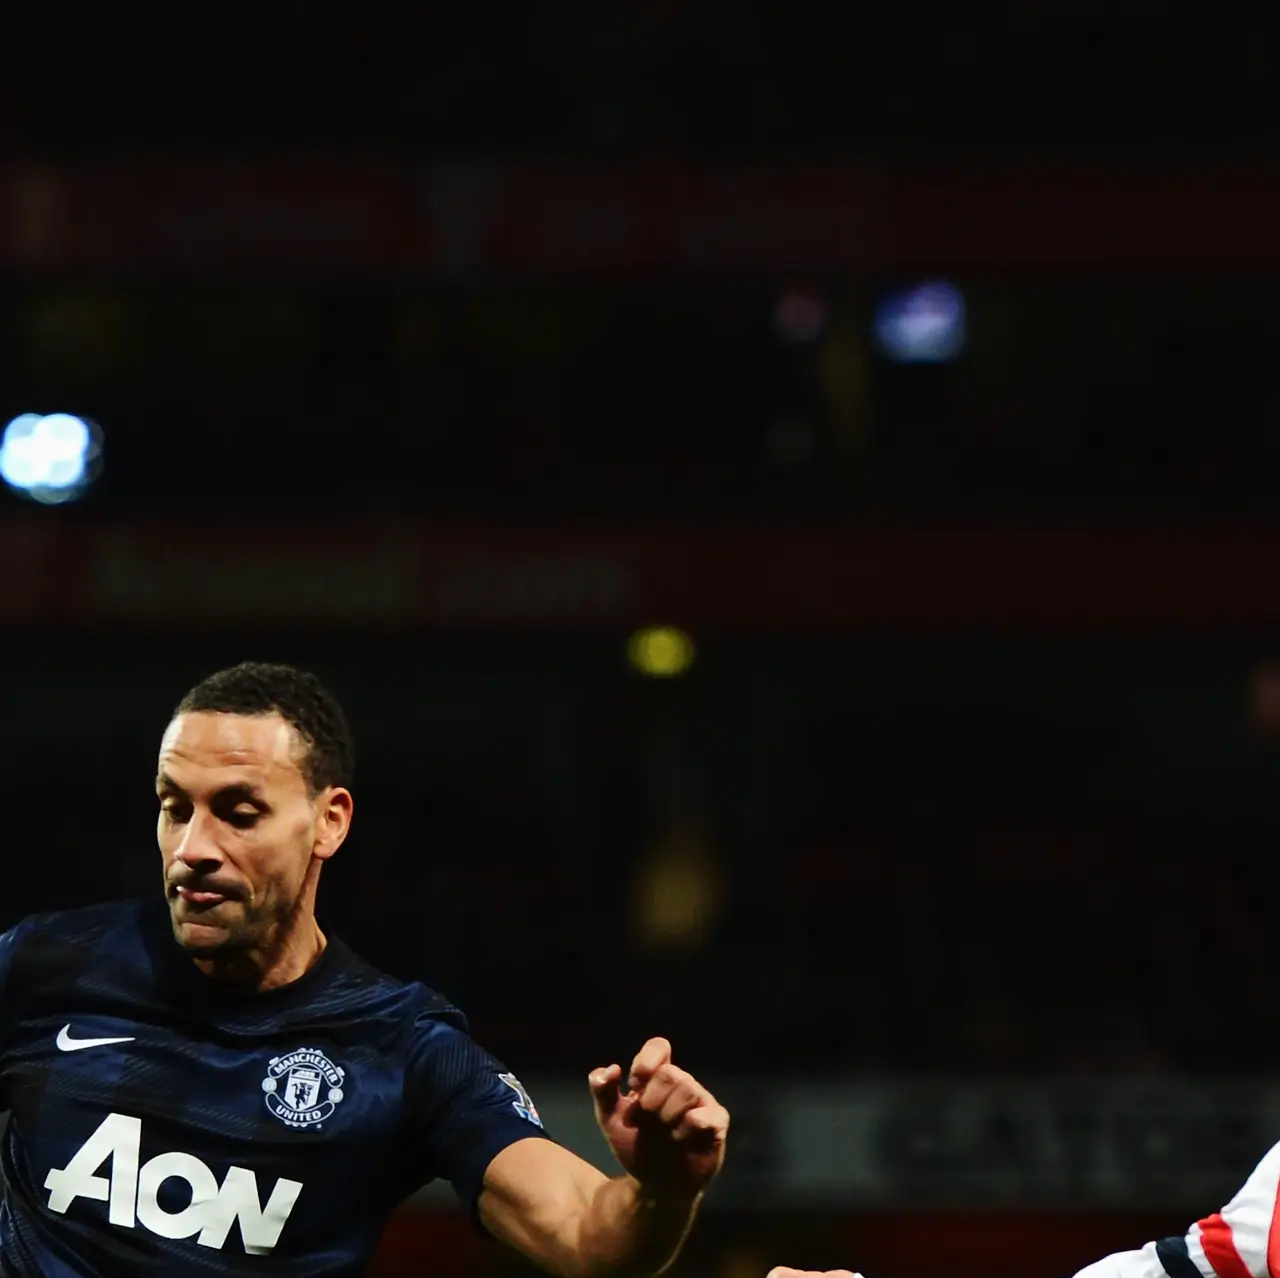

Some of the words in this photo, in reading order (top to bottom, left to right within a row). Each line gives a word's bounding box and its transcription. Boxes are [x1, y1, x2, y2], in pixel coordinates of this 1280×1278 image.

[273, 1053, 339, 1084] MANCHESTER
[275, 1104, 322, 1122] UNITED
[43, 1112, 304, 1256] AON
